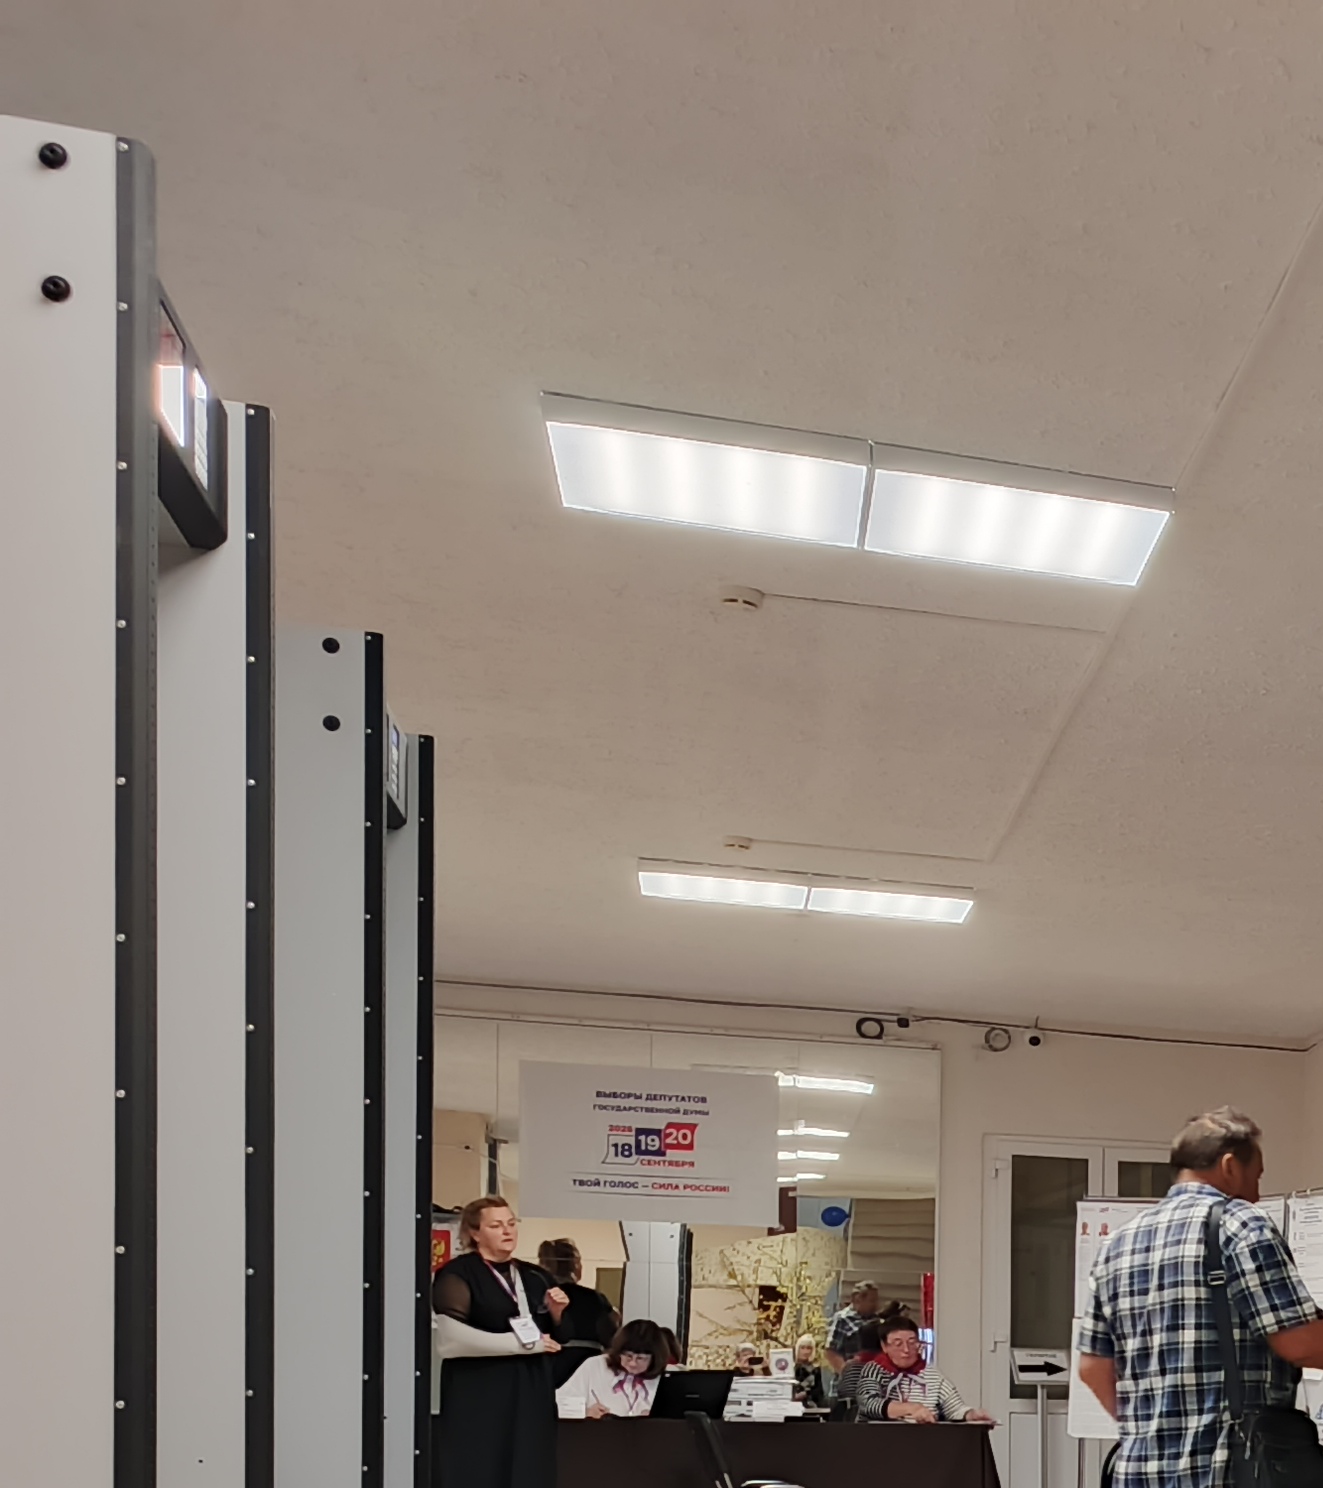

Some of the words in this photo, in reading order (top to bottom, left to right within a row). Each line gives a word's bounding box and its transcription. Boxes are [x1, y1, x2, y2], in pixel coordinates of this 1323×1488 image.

[595, 1090, 643, 1101] ВЫБОРЫ
[645, 1093, 708, 1104] ДЕПУТАТОВ
[593, 1103, 681, 1115] ГОСУДАРСТВЕННОЙ
[682, 1108, 710, 1116] ДУМЫ
[611, 1143, 633, 1158] 18
[637, 1135, 661, 1151] 19
[665, 1128, 692, 1145] 20
[640, 1158, 696, 1168] СЕНТЯБРЯ
[572, 1178, 601, 1188] ТВОЙ
[603, 1180, 639, 1189] ГОЛОС
[651, 1182, 680, 1192] СИЛА
[683, 1184, 730, 1193] РОССИИ!
